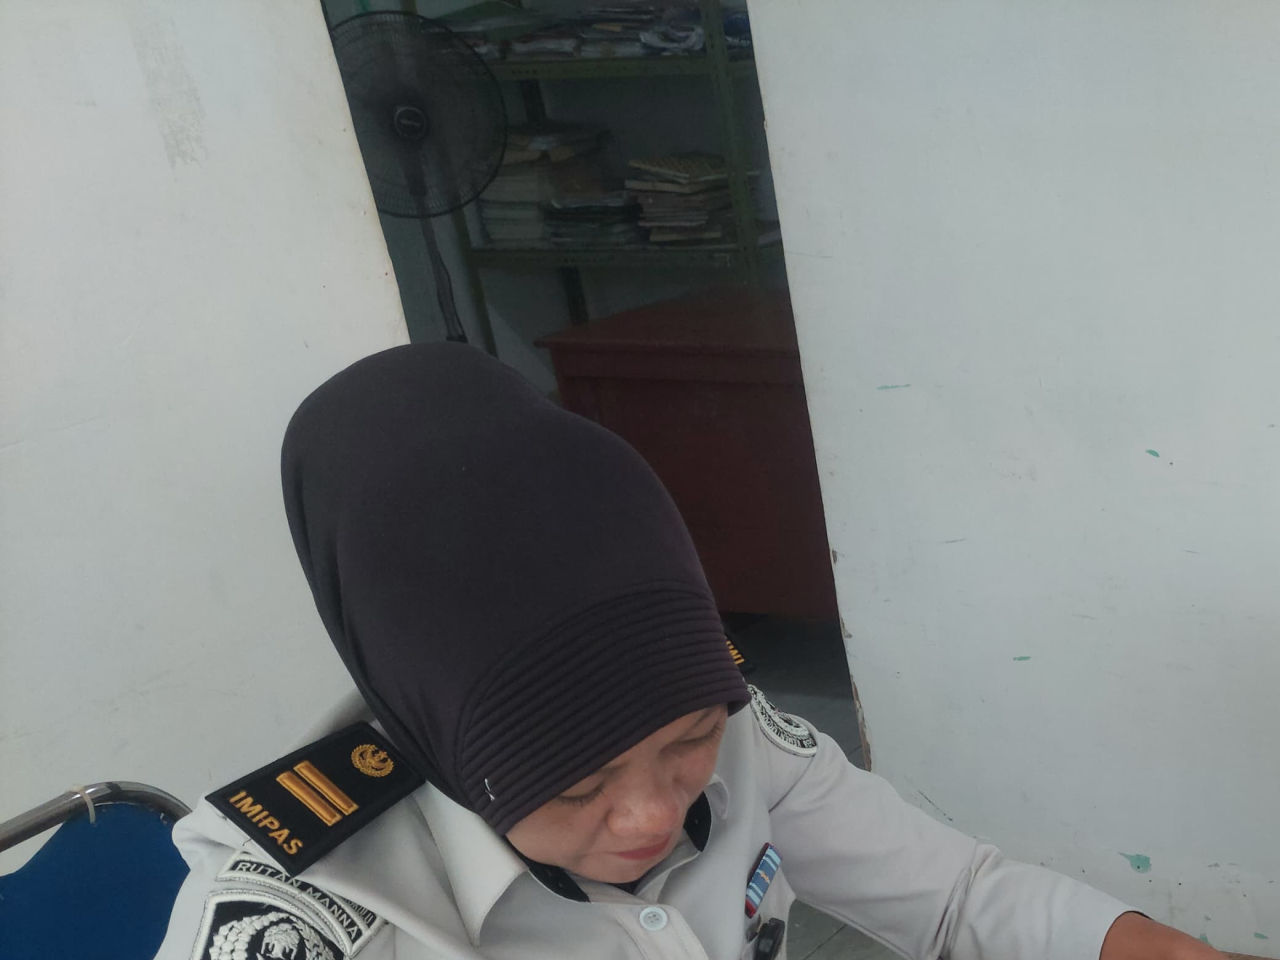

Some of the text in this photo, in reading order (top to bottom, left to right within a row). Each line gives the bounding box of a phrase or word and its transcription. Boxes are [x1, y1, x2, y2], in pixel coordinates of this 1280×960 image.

[229, 790, 304, 856] IMIPAS
[235, 862, 360, 941] RUTAN MANNA
